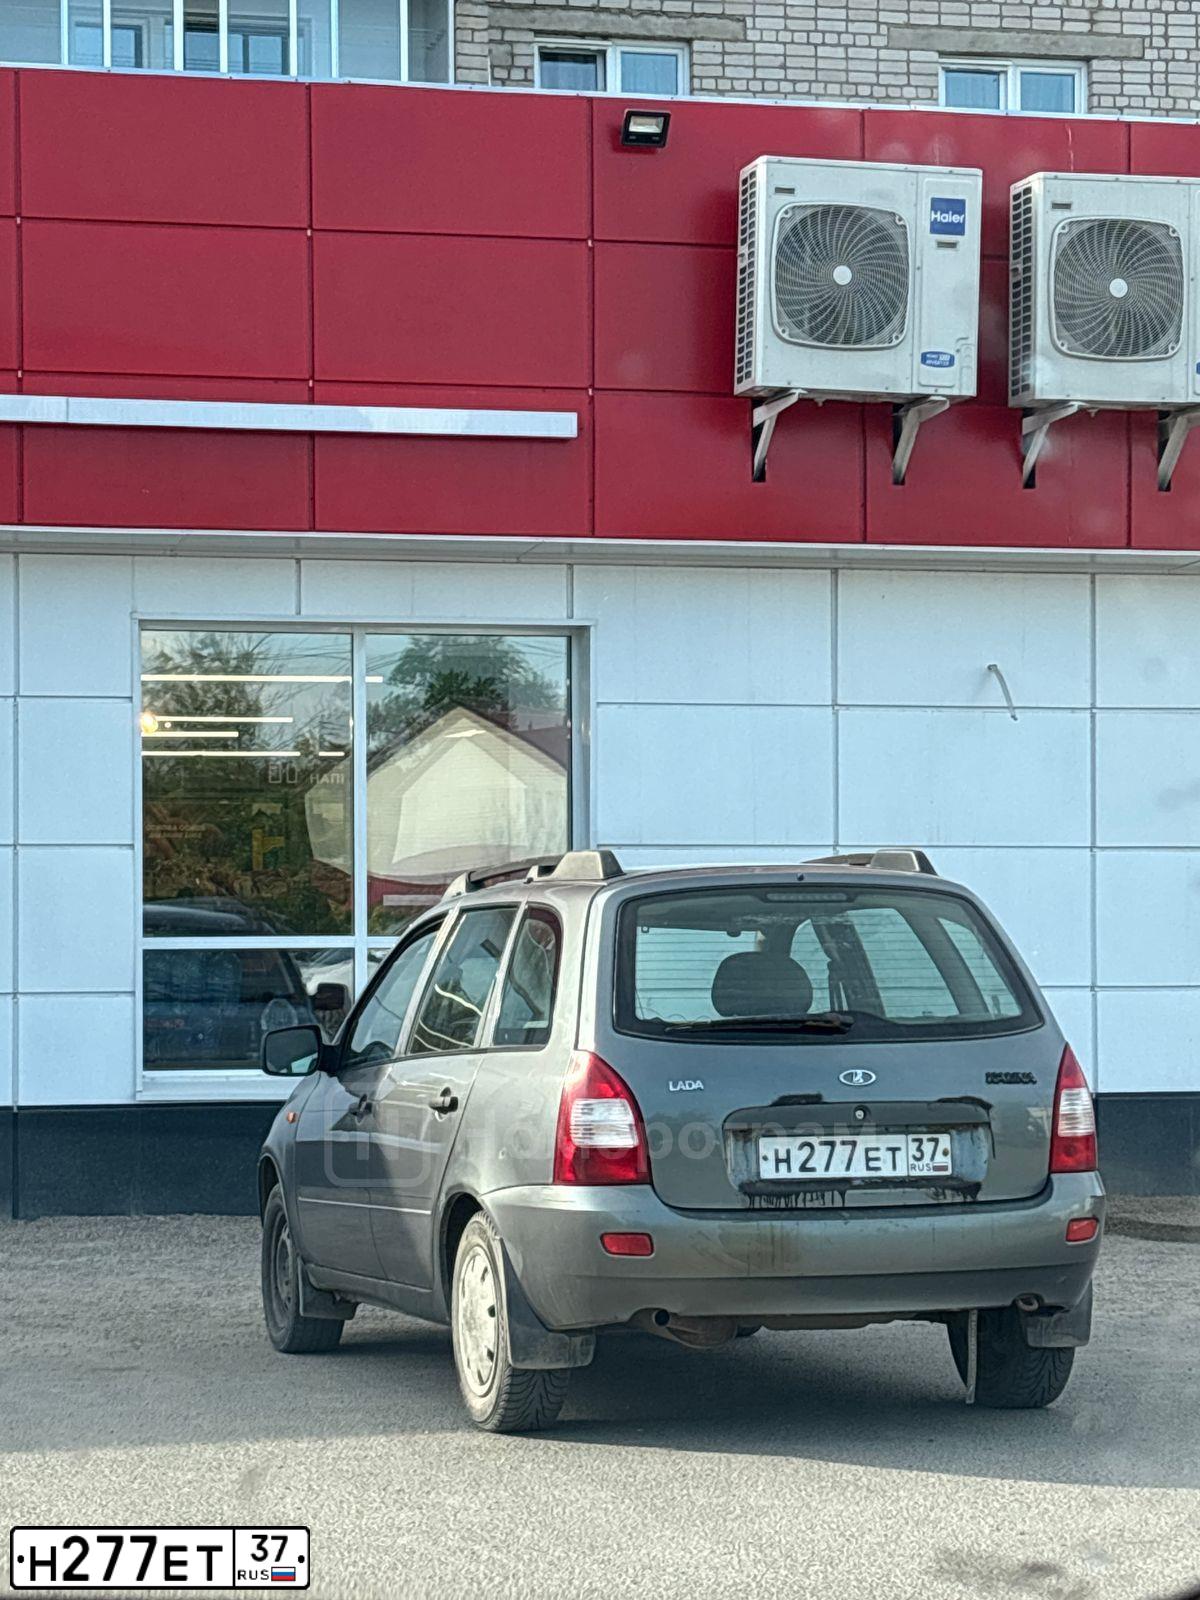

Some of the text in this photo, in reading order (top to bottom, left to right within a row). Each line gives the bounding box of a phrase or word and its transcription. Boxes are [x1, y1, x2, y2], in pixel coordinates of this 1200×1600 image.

[931, 210, 964, 223] Haier
[669, 1080, 704, 1091] LADA
[774, 1137, 940, 1173] Н277ЕТ 37
[910, 1163, 931, 1172] RUS
